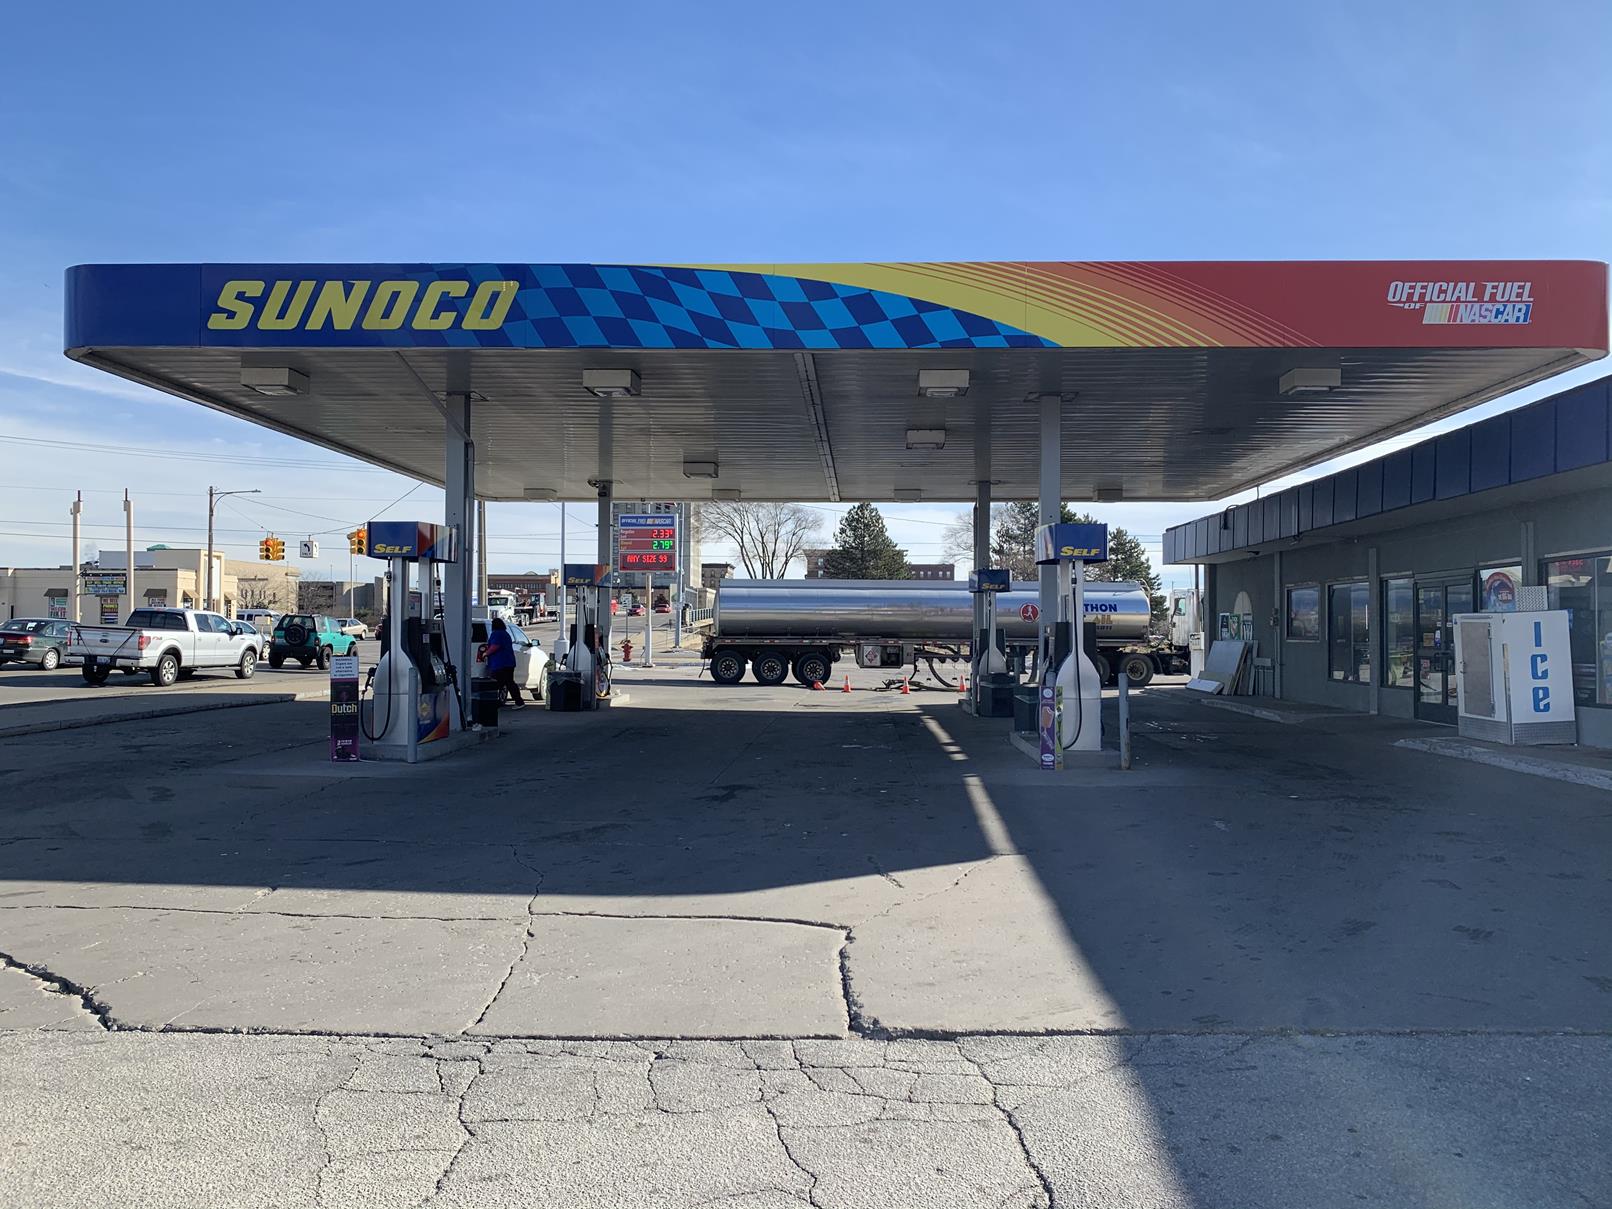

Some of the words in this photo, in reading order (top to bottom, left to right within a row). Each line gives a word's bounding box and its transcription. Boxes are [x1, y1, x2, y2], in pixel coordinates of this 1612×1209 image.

[1387, 281, 1478, 302] OFFICIAL
[1481, 281, 1534, 302] FUEL
[206, 280, 520, 331] SUNOCO
[1455, 304, 1527, 323] NASCAR
[373, 543, 413, 554] SELF
[1060, 545, 1101, 557] SELF
[642, 555, 657, 563] SIZE
[1083, 603, 1118, 613] THON
[331, 703, 358, 714] Dutch
